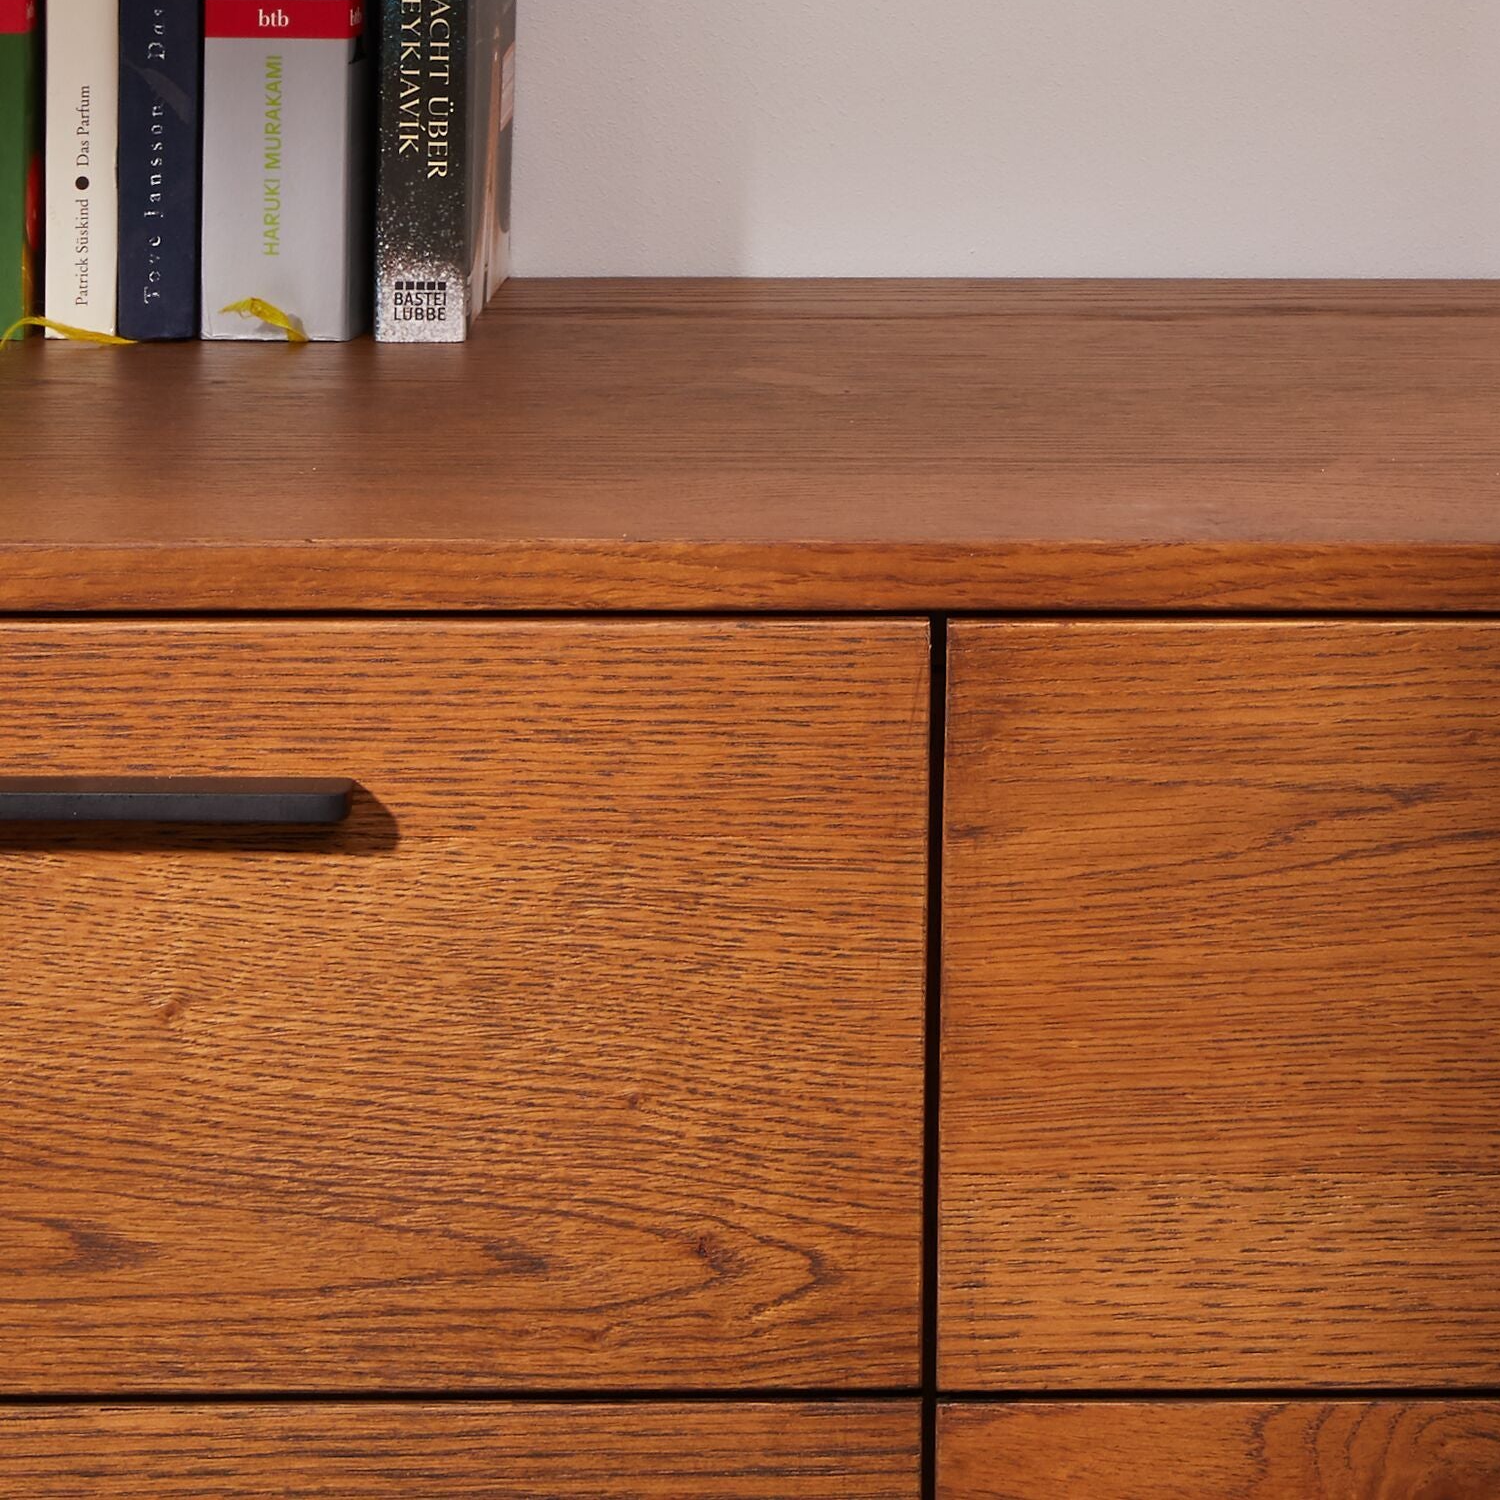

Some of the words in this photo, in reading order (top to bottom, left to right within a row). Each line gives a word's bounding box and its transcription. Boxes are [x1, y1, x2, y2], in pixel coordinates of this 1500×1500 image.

[258, 8, 289, 27] btb
[76, 85, 90, 135] Parfum
[264, 55, 283, 169] MURAKAMI
[76, 140, 90, 166] Das
[427, 97, 454, 179] ÜBER
[75, 198, 89, 253] Süskind
[263, 179, 281, 256] HARUKI
[75, 257, 89, 306] Patrick
[394, 292, 446, 306] BASTEI
